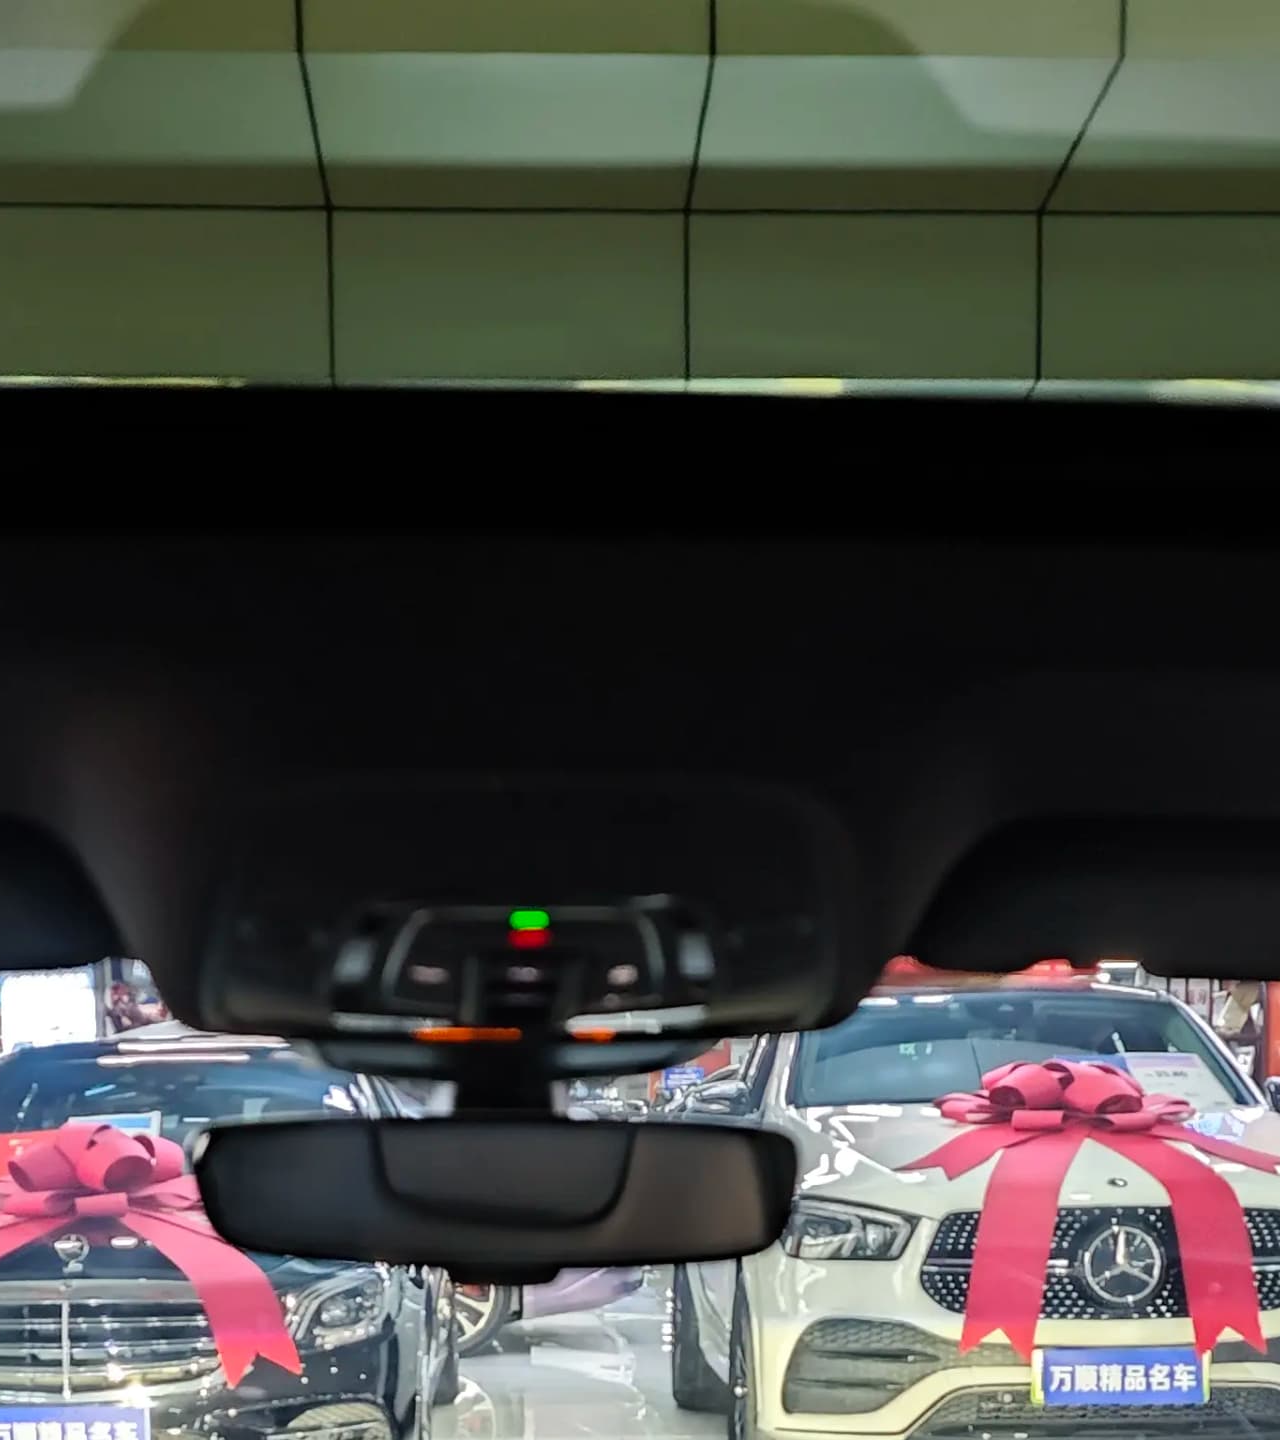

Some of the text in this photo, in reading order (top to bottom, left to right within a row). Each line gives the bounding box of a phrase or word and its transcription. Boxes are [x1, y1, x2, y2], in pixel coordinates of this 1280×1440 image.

[1048, 1362, 1198, 1394] 万顺精品名车
